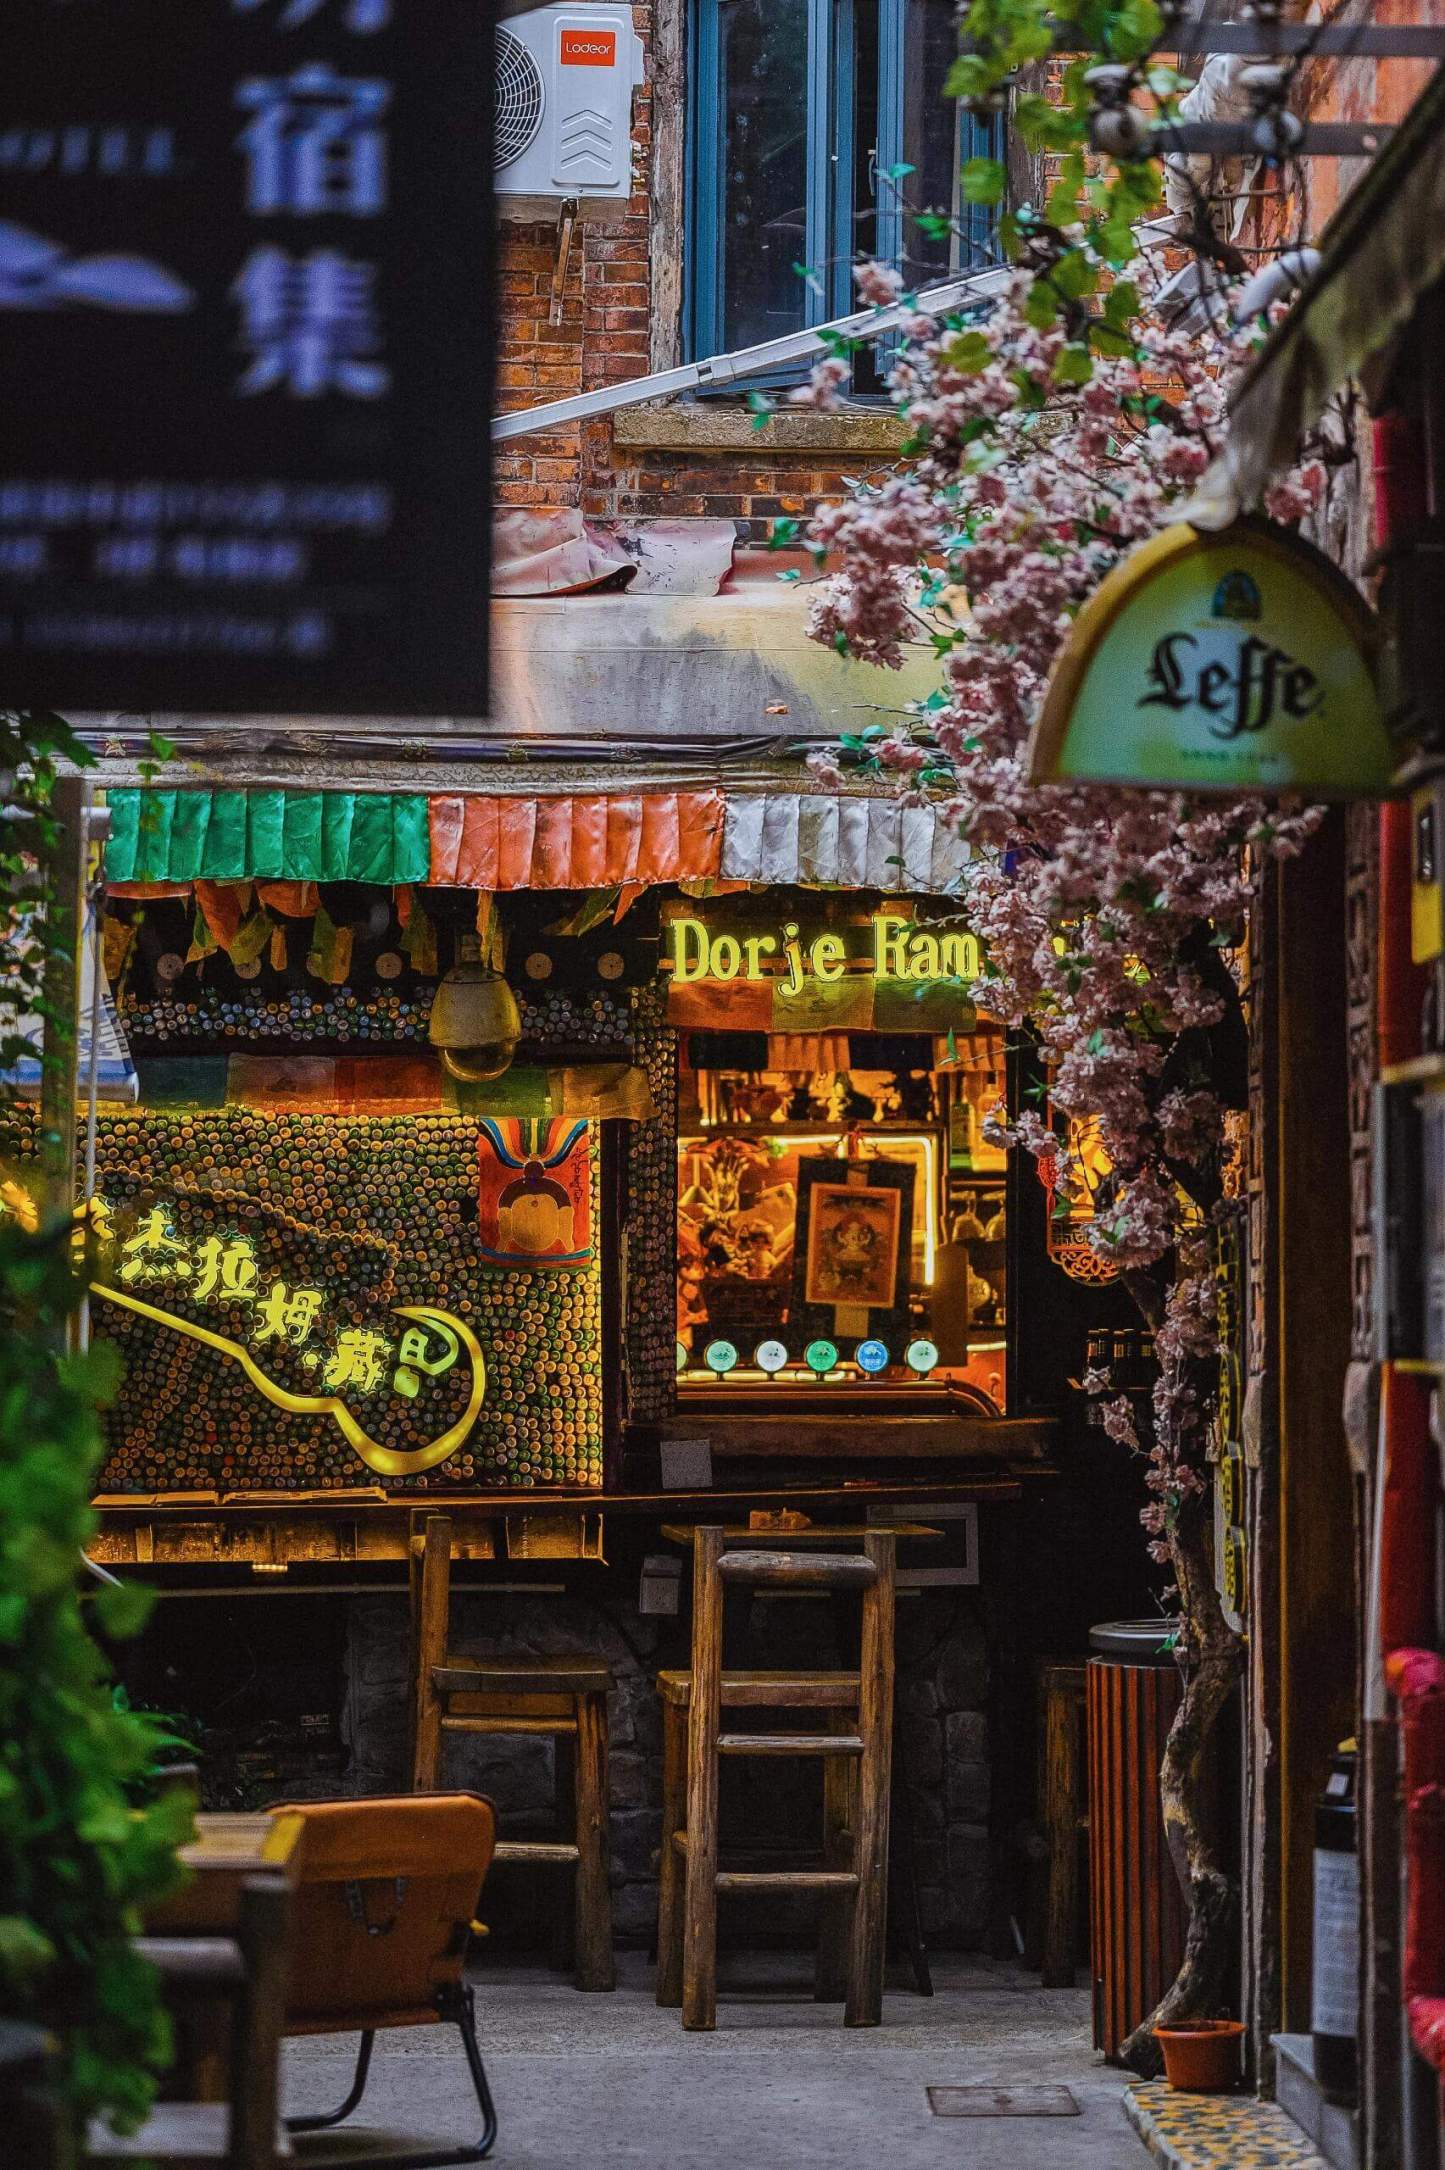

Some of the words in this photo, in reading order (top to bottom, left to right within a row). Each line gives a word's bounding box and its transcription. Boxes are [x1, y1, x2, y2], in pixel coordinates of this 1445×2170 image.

[234, 0, 393, 396] 宿集
[1136, 631, 1326, 740] Leffe
[671, 918, 846, 997] Dorje
